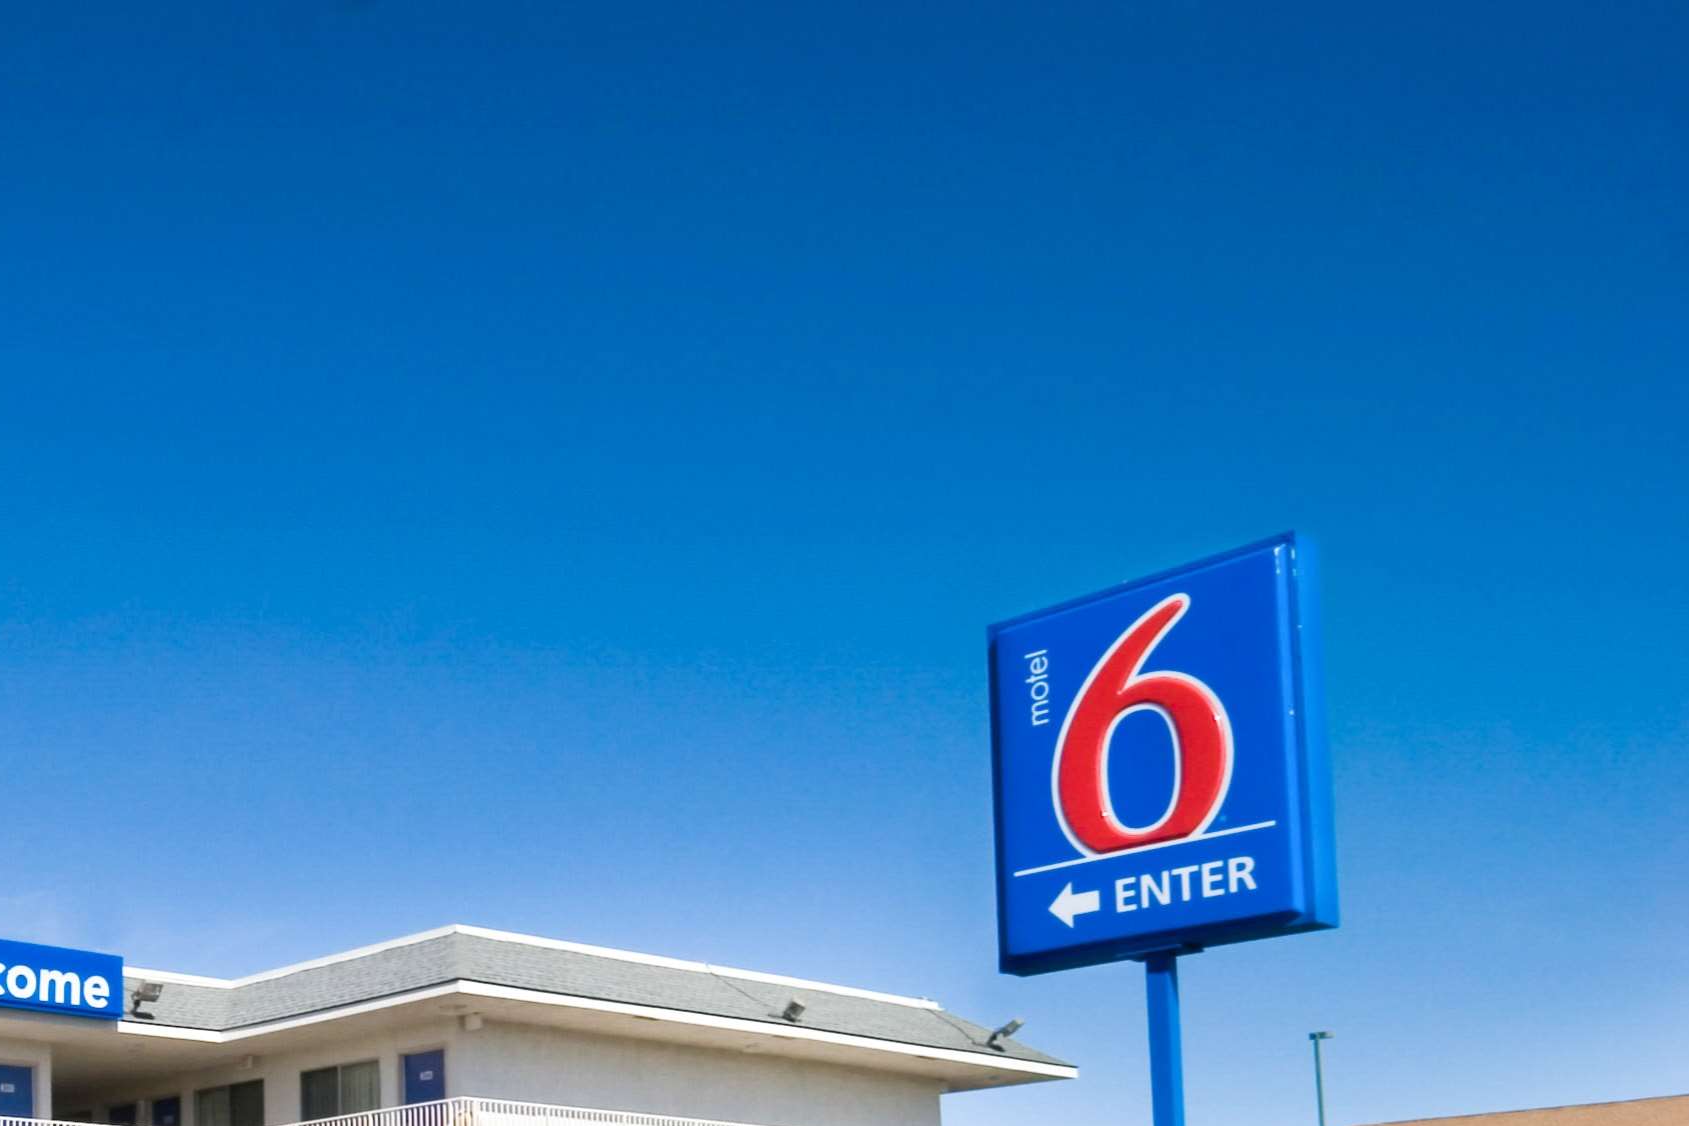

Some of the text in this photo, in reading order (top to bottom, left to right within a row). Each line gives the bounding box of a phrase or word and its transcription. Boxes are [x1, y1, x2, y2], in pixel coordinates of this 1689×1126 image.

[1024, 650, 1049, 726] motel
[1051, 593, 1234, 859] 6
[1115, 856, 1257, 913] ENTER
